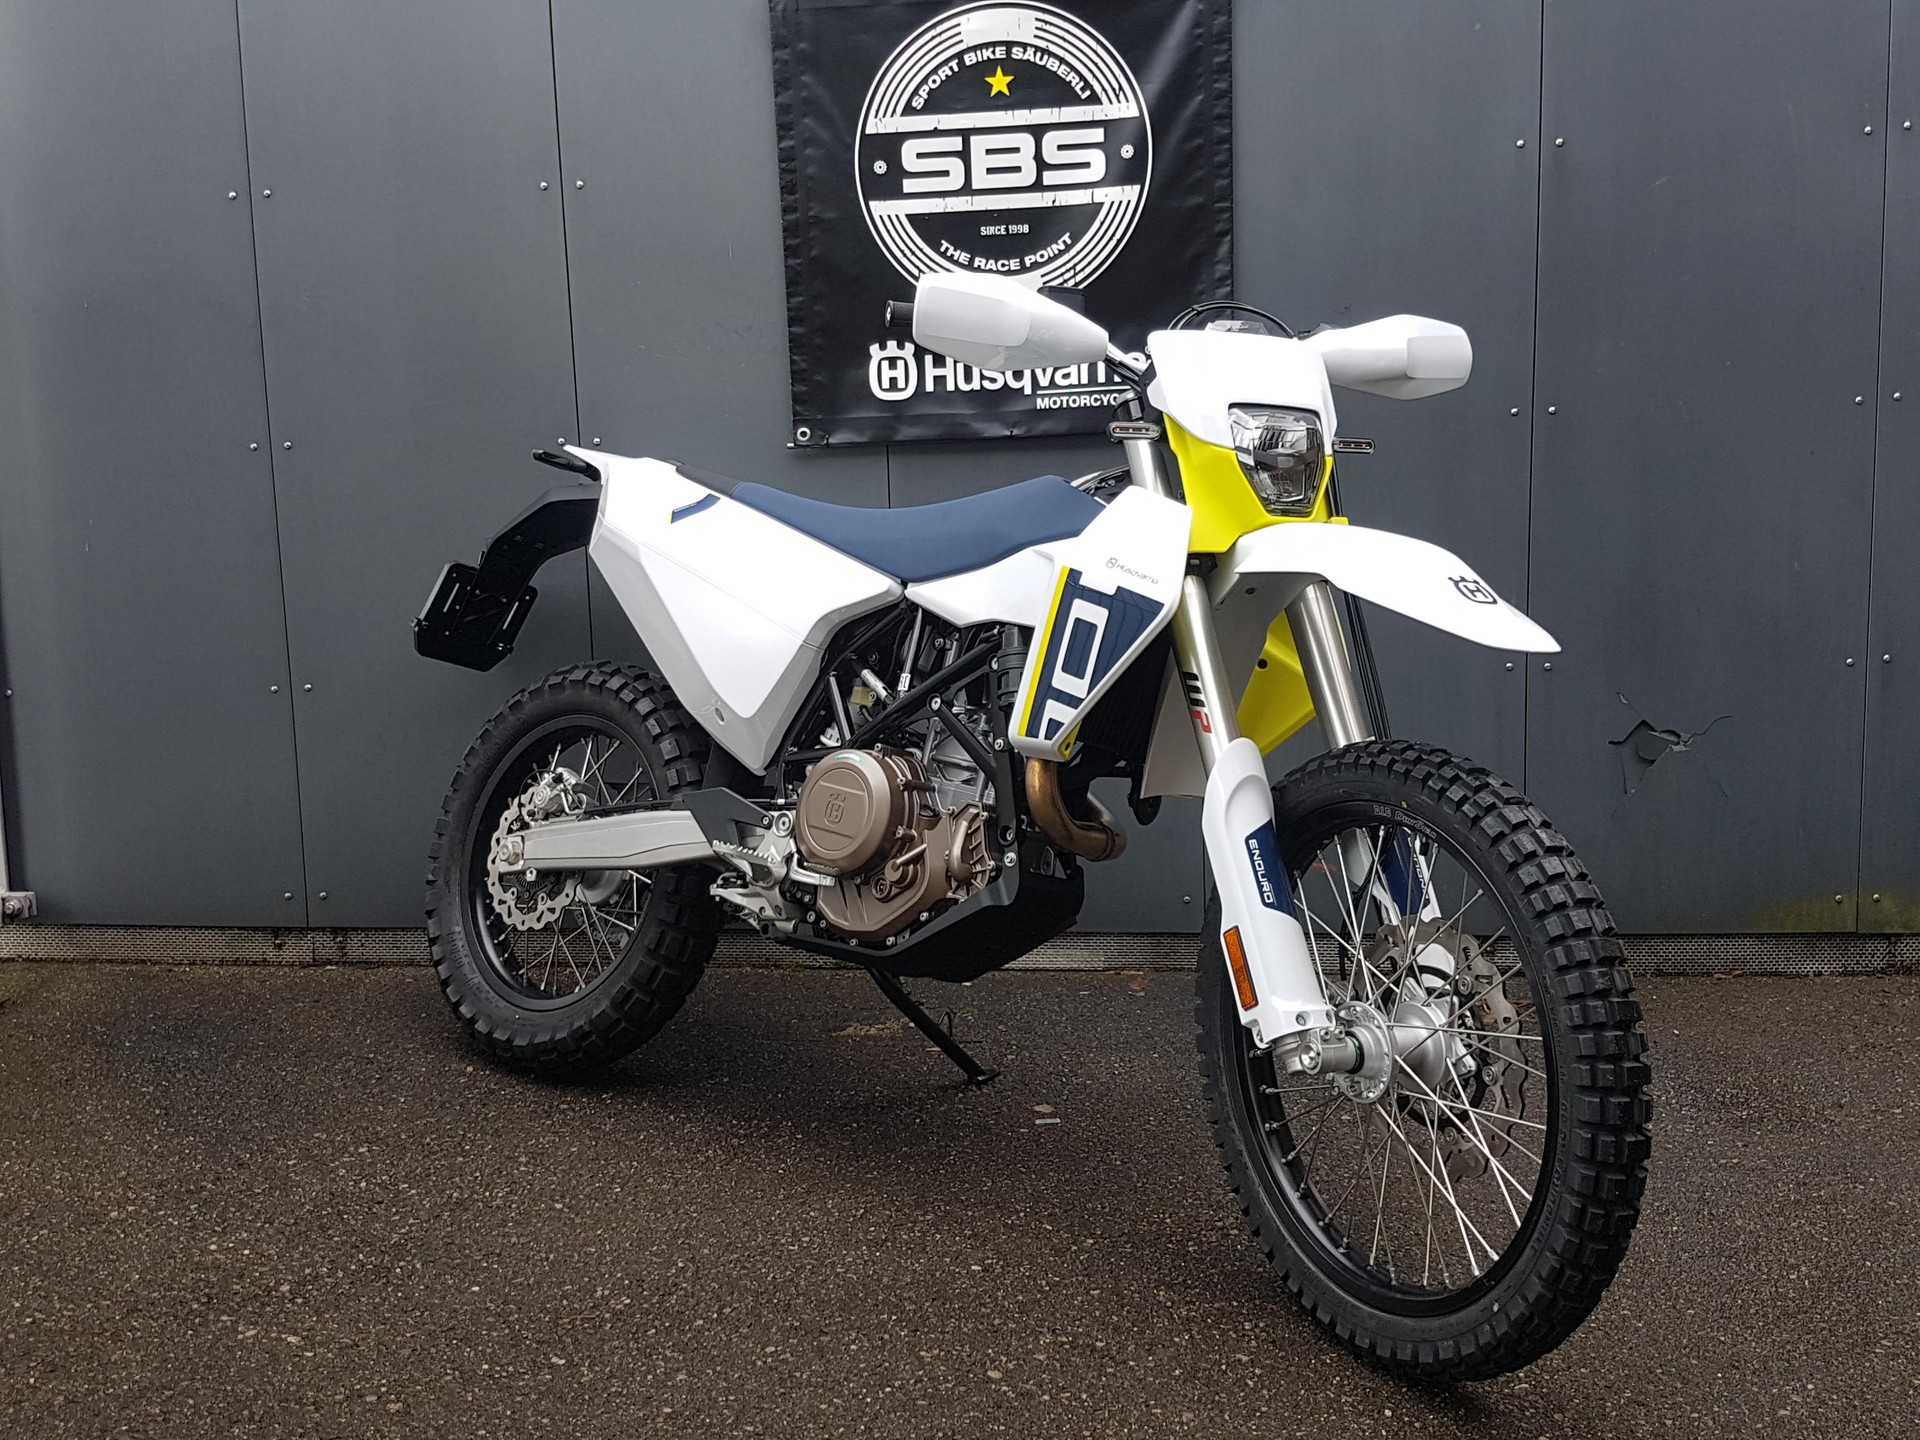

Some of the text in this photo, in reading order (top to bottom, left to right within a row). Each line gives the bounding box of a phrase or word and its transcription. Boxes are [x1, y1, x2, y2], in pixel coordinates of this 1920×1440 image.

[911, 46, 1092, 110] SPORT BIKE SÄUBERLI
[901, 128, 1106, 193] SBS
[940, 232, 1072, 271] THE RACE POINT
[980, 224, 1029, 236] SINCE 1998
[924, 352, 1147, 396] Husqvarn
[1036, 393, 1120, 410] MOTORCYC
[1248, 838, 1274, 904] ENDURO
